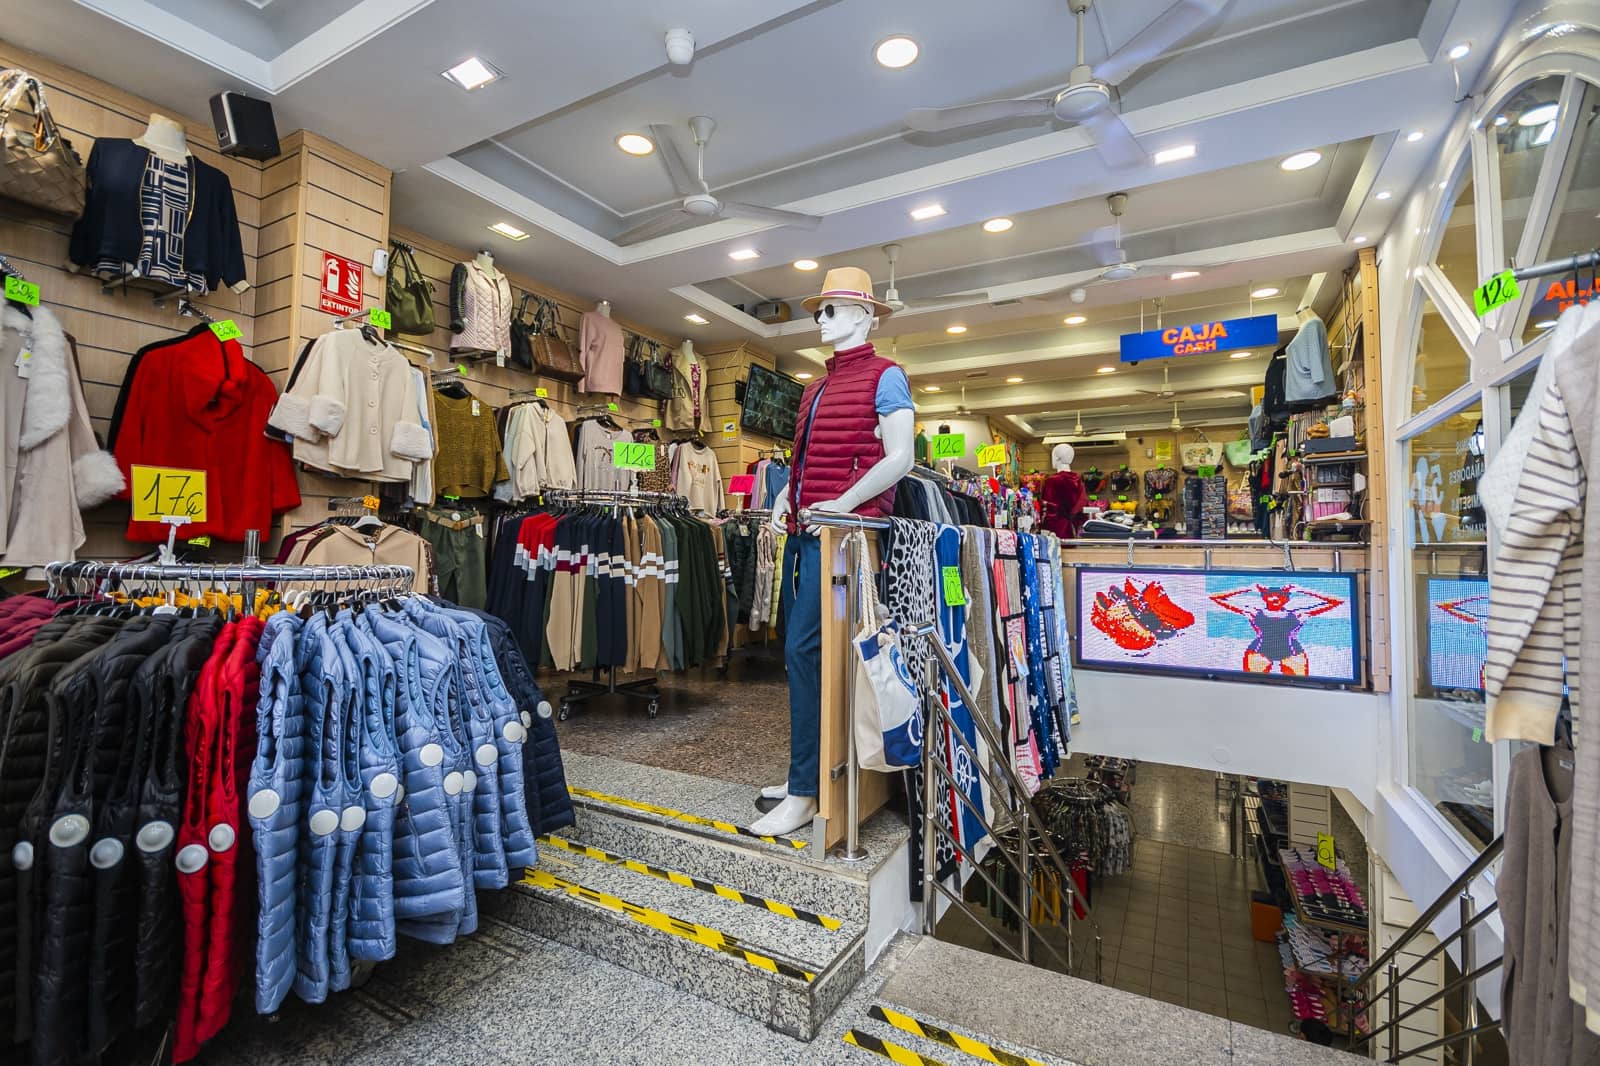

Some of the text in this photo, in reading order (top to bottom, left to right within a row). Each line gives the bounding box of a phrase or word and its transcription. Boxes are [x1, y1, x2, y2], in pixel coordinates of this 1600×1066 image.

[322, 298, 360, 314] EXTINTOR
[1162, 321, 1228, 345] CAJA
[1173, 339, 1217, 355] CASH
[143, 472, 203, 517] 17€
